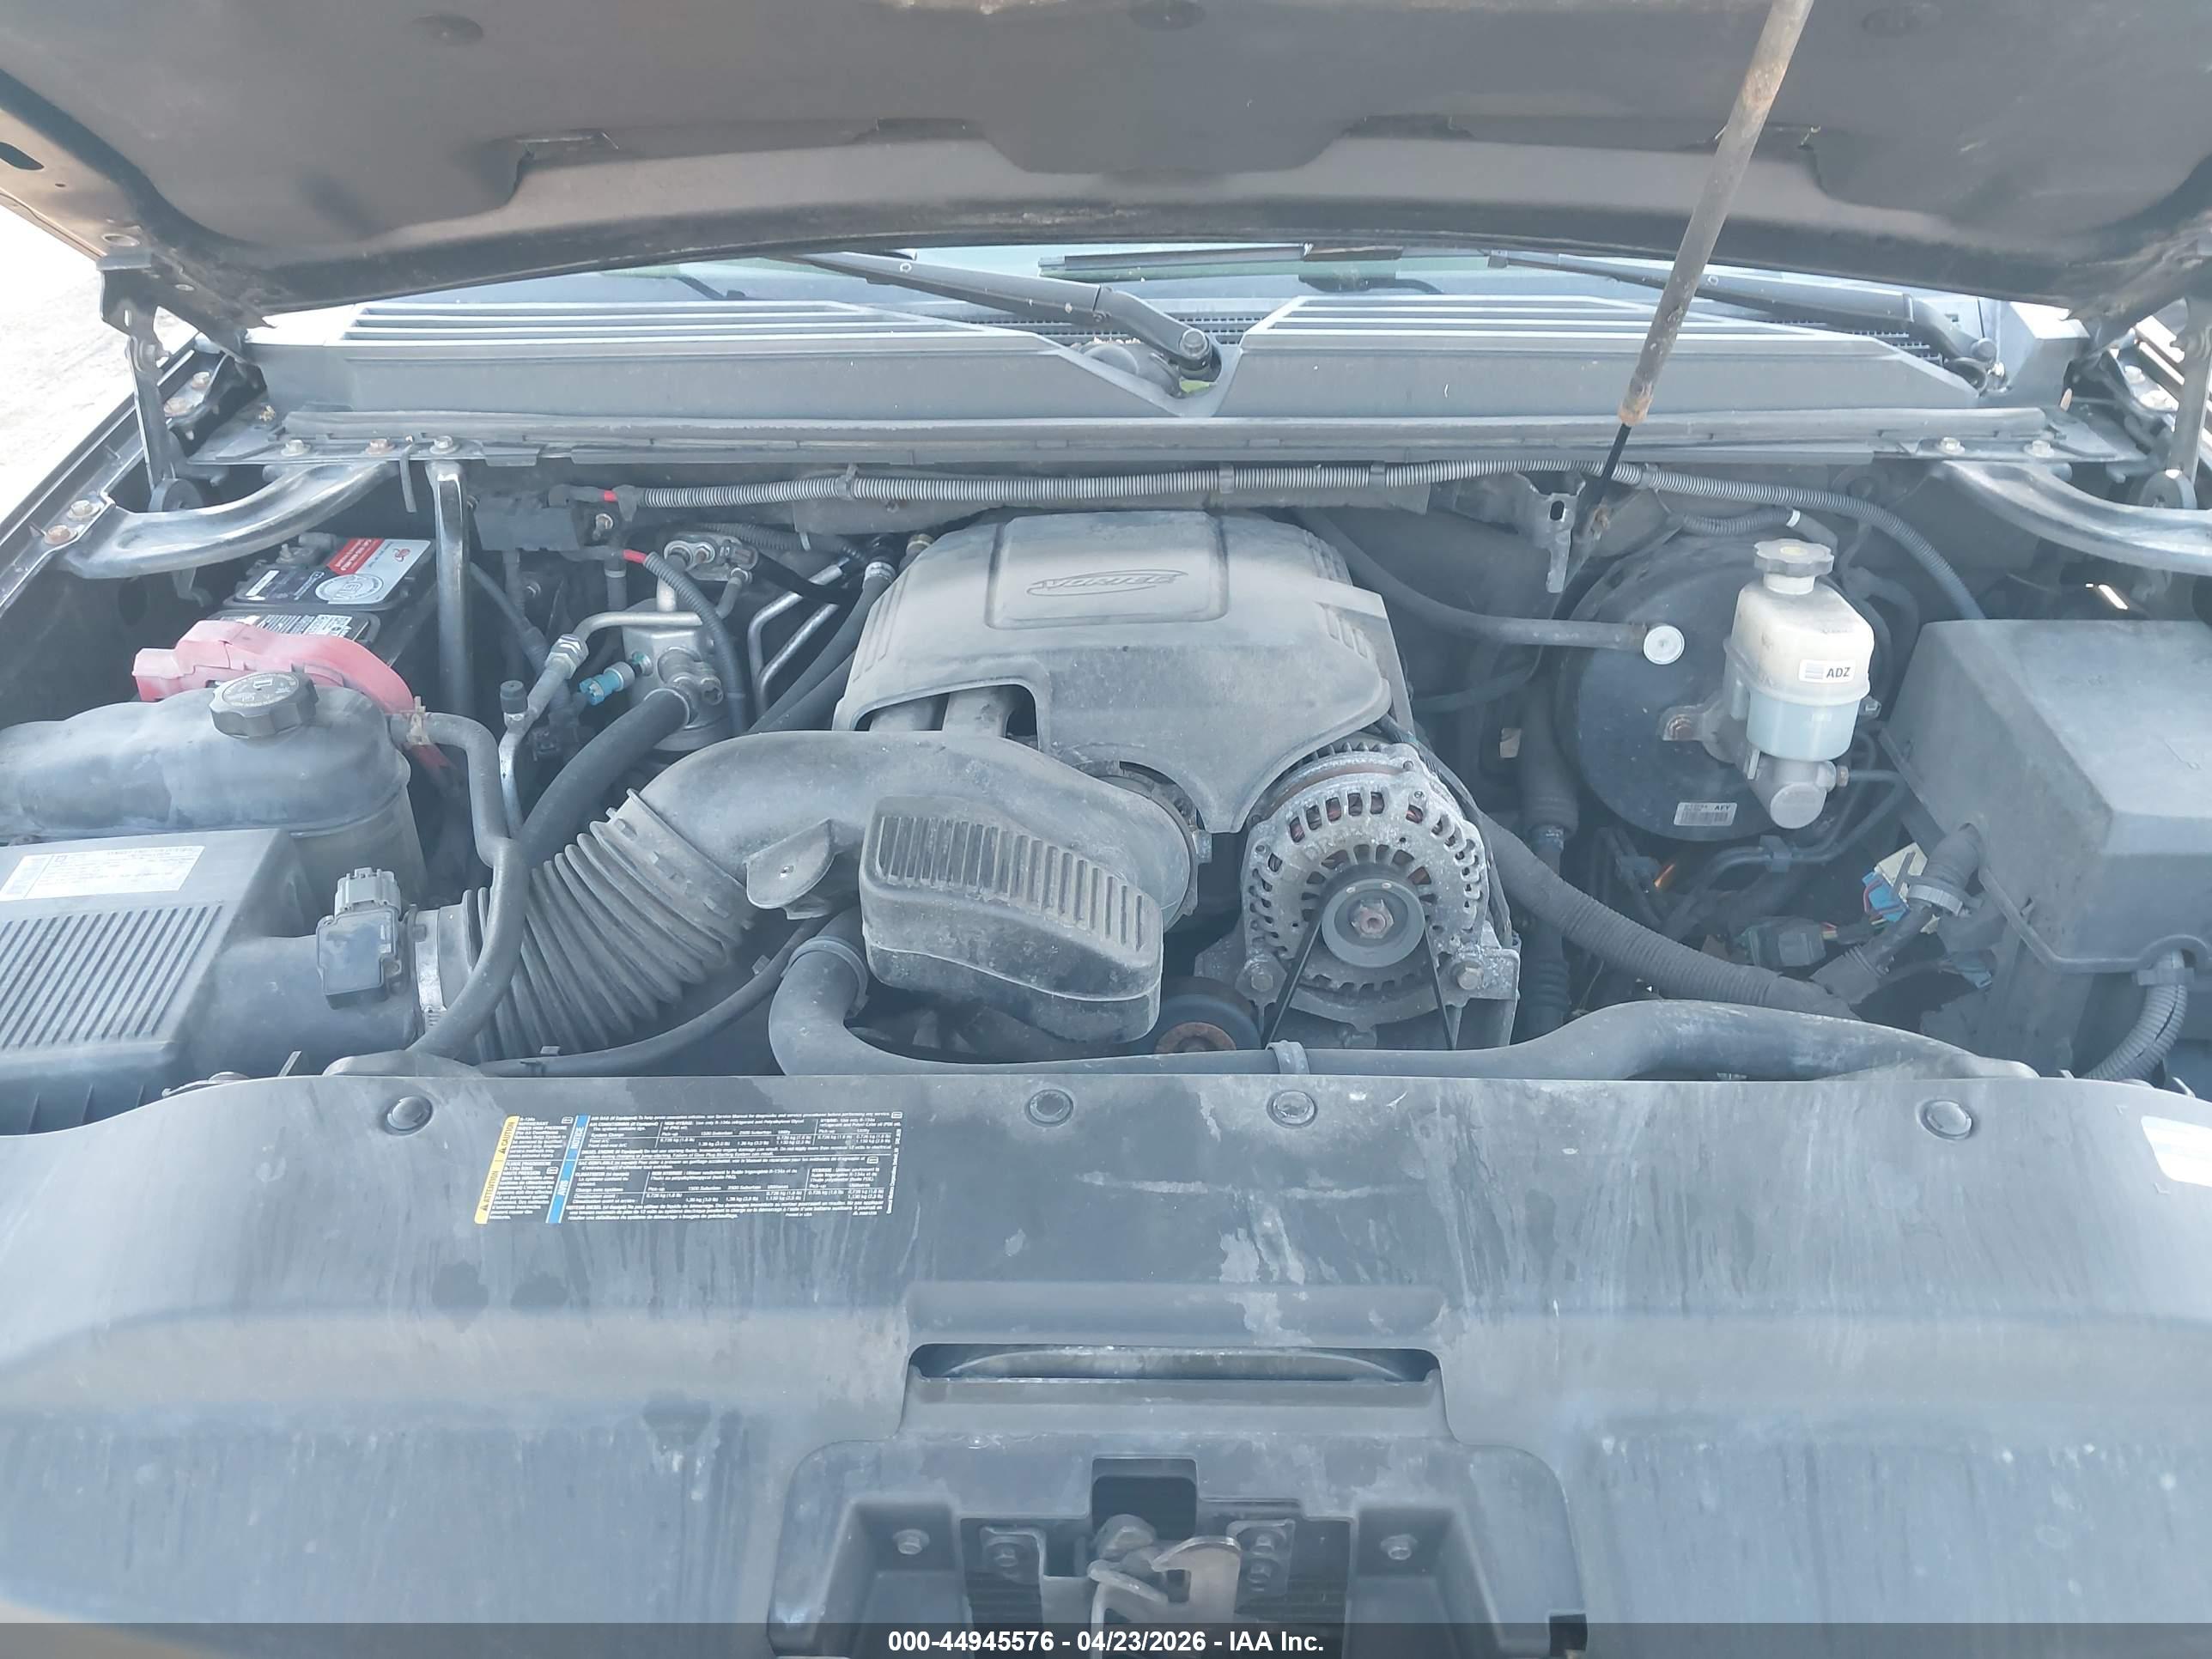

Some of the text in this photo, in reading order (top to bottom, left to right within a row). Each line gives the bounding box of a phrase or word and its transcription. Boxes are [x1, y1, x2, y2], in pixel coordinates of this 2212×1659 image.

[1826, 666, 1851, 678] ADZ
[501, 1121, 514, 1147] CAUTION
[571, 1126, 584, 1149] NOTICE
[483, 1170, 500, 1203] ATTENTION
[557, 1180, 568, 1196] AVIS
